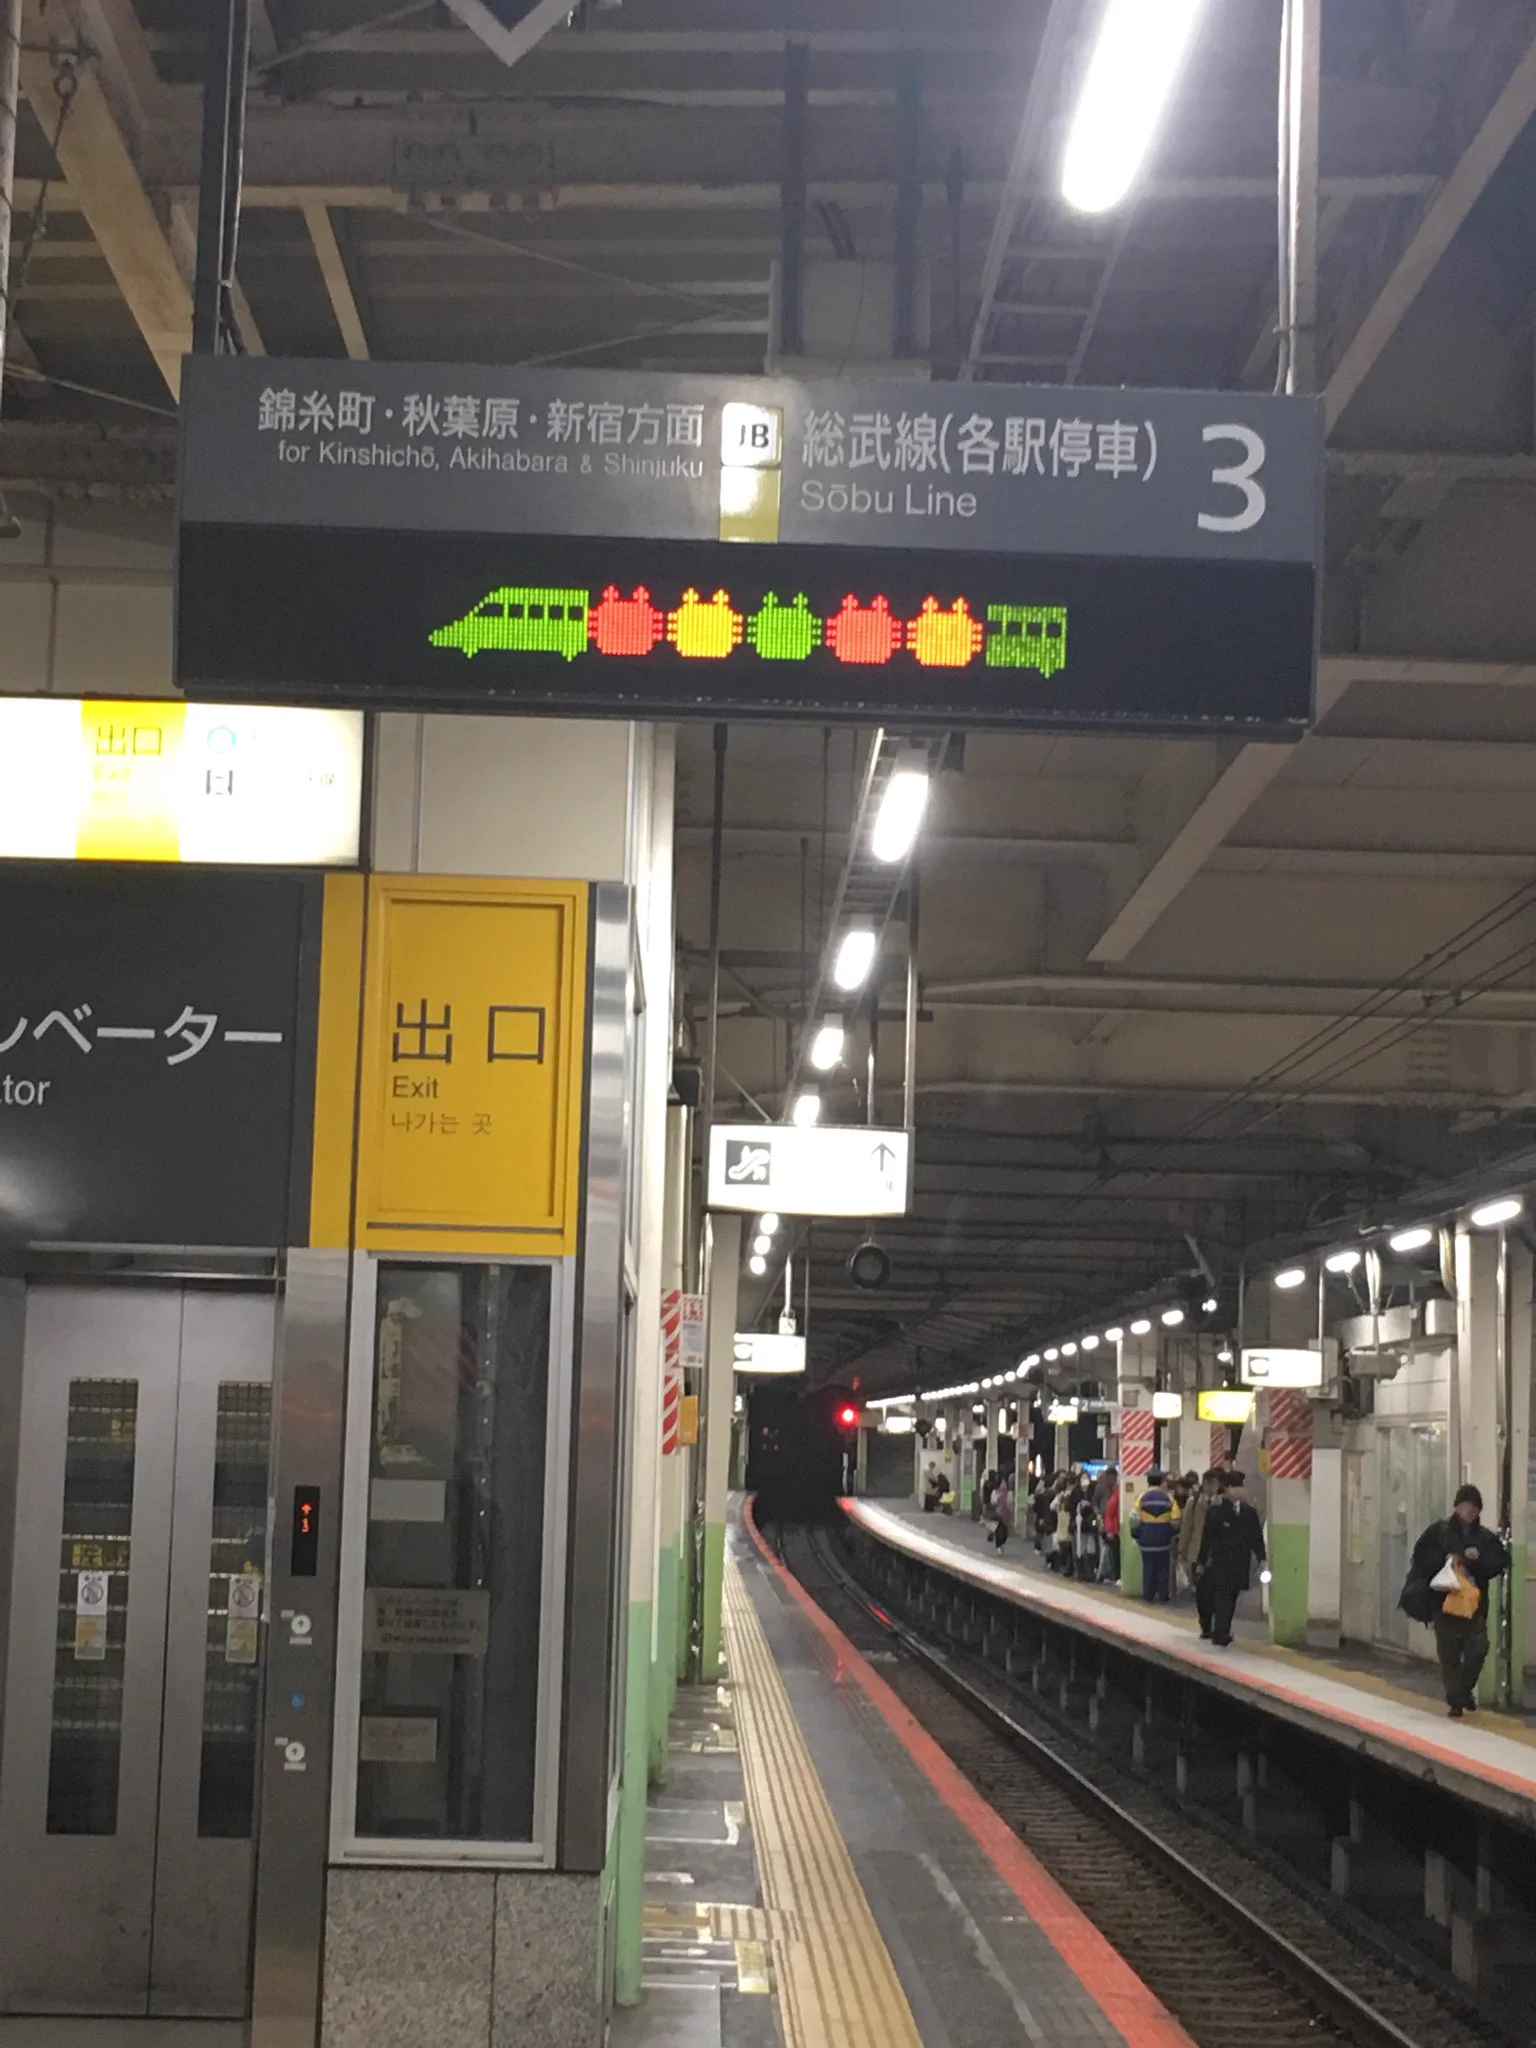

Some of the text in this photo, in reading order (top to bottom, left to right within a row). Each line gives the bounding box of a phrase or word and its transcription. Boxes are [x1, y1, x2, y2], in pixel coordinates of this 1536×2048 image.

[258, 386, 705, 447] 錦糸町・秋葉原・新宿方面
[738, 422, 769, 448] JB
[278, 442, 311, 462] for
[449, 446, 569, 475] Akihabara
[580, 455, 593, 475] &
[604, 452, 704, 480] Shinjuku
[801, 409, 1159, 482] 総武線(各駅停車)
[1197, 422, 1268, 533] 3
[800, 479, 978, 518] Sōbu Line
[391, 998, 546, 1064] 出口
[392, 1075, 439, 1099] Exit
[391, 1111, 492, 1135] 나가는 곳
